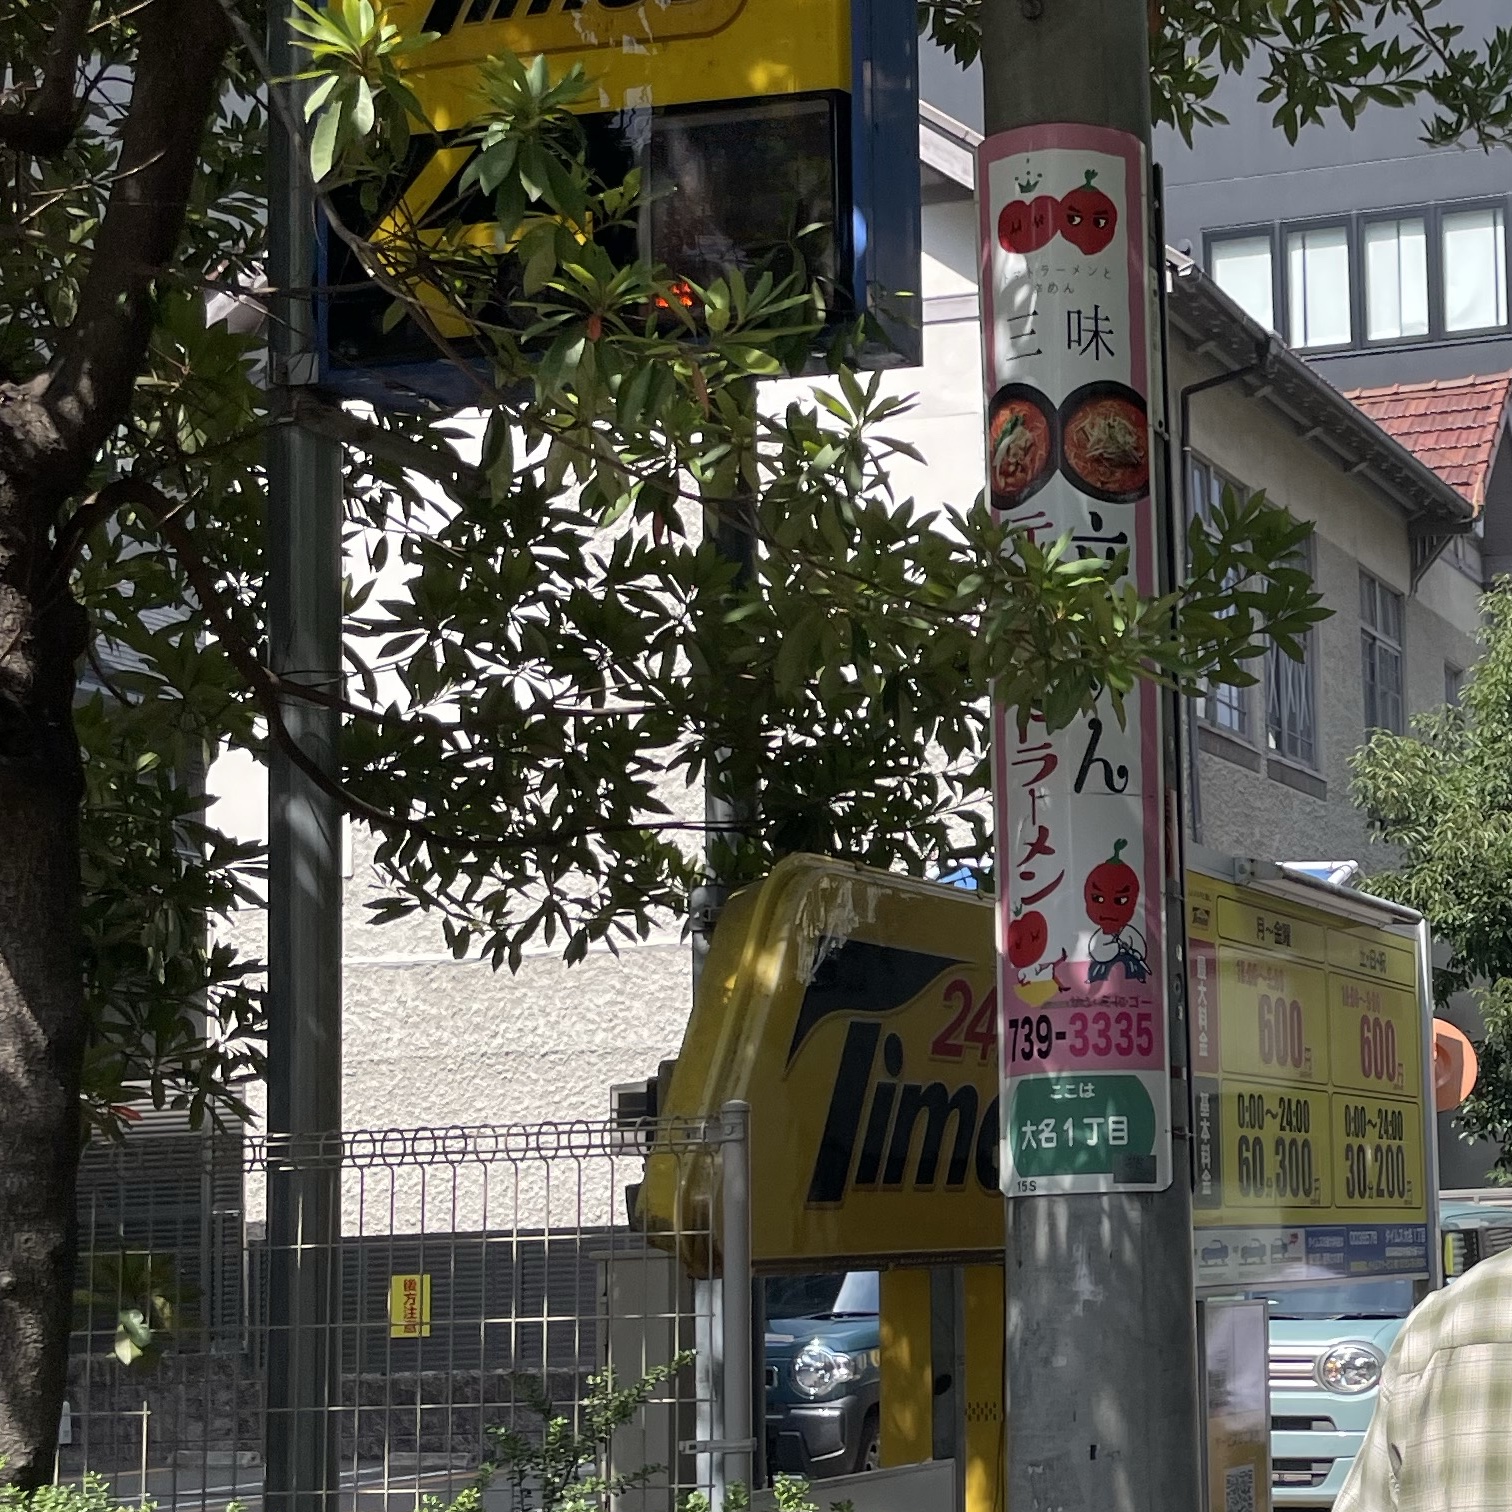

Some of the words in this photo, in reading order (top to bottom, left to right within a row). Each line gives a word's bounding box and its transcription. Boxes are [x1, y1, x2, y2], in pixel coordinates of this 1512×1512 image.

[1005, 304, 1116, 361] 三味
[1008, 1012, 1154, 1062] 739-3335
[1050, 1083, 1096, 1099] ここは
[1021, 1115, 1129, 1150] 大名1丁目
